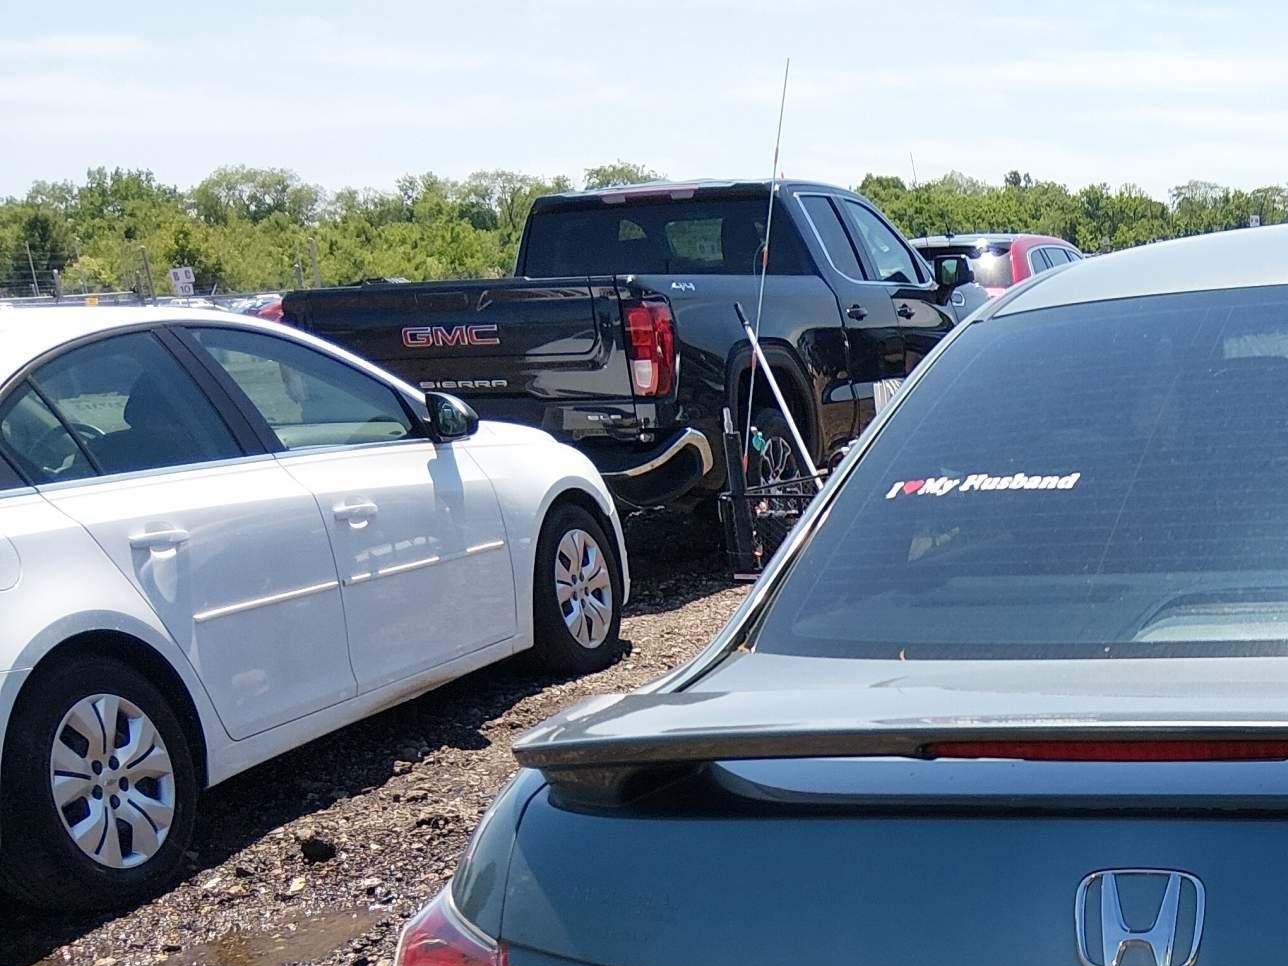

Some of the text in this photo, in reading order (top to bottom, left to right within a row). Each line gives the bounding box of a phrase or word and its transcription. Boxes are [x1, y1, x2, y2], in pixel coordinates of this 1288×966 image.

[401, 324, 501, 348] GMC
[419, 379, 508, 390] SIERRA
[917, 476, 960, 497] My
[959, 472, 1081, 492] Husband
